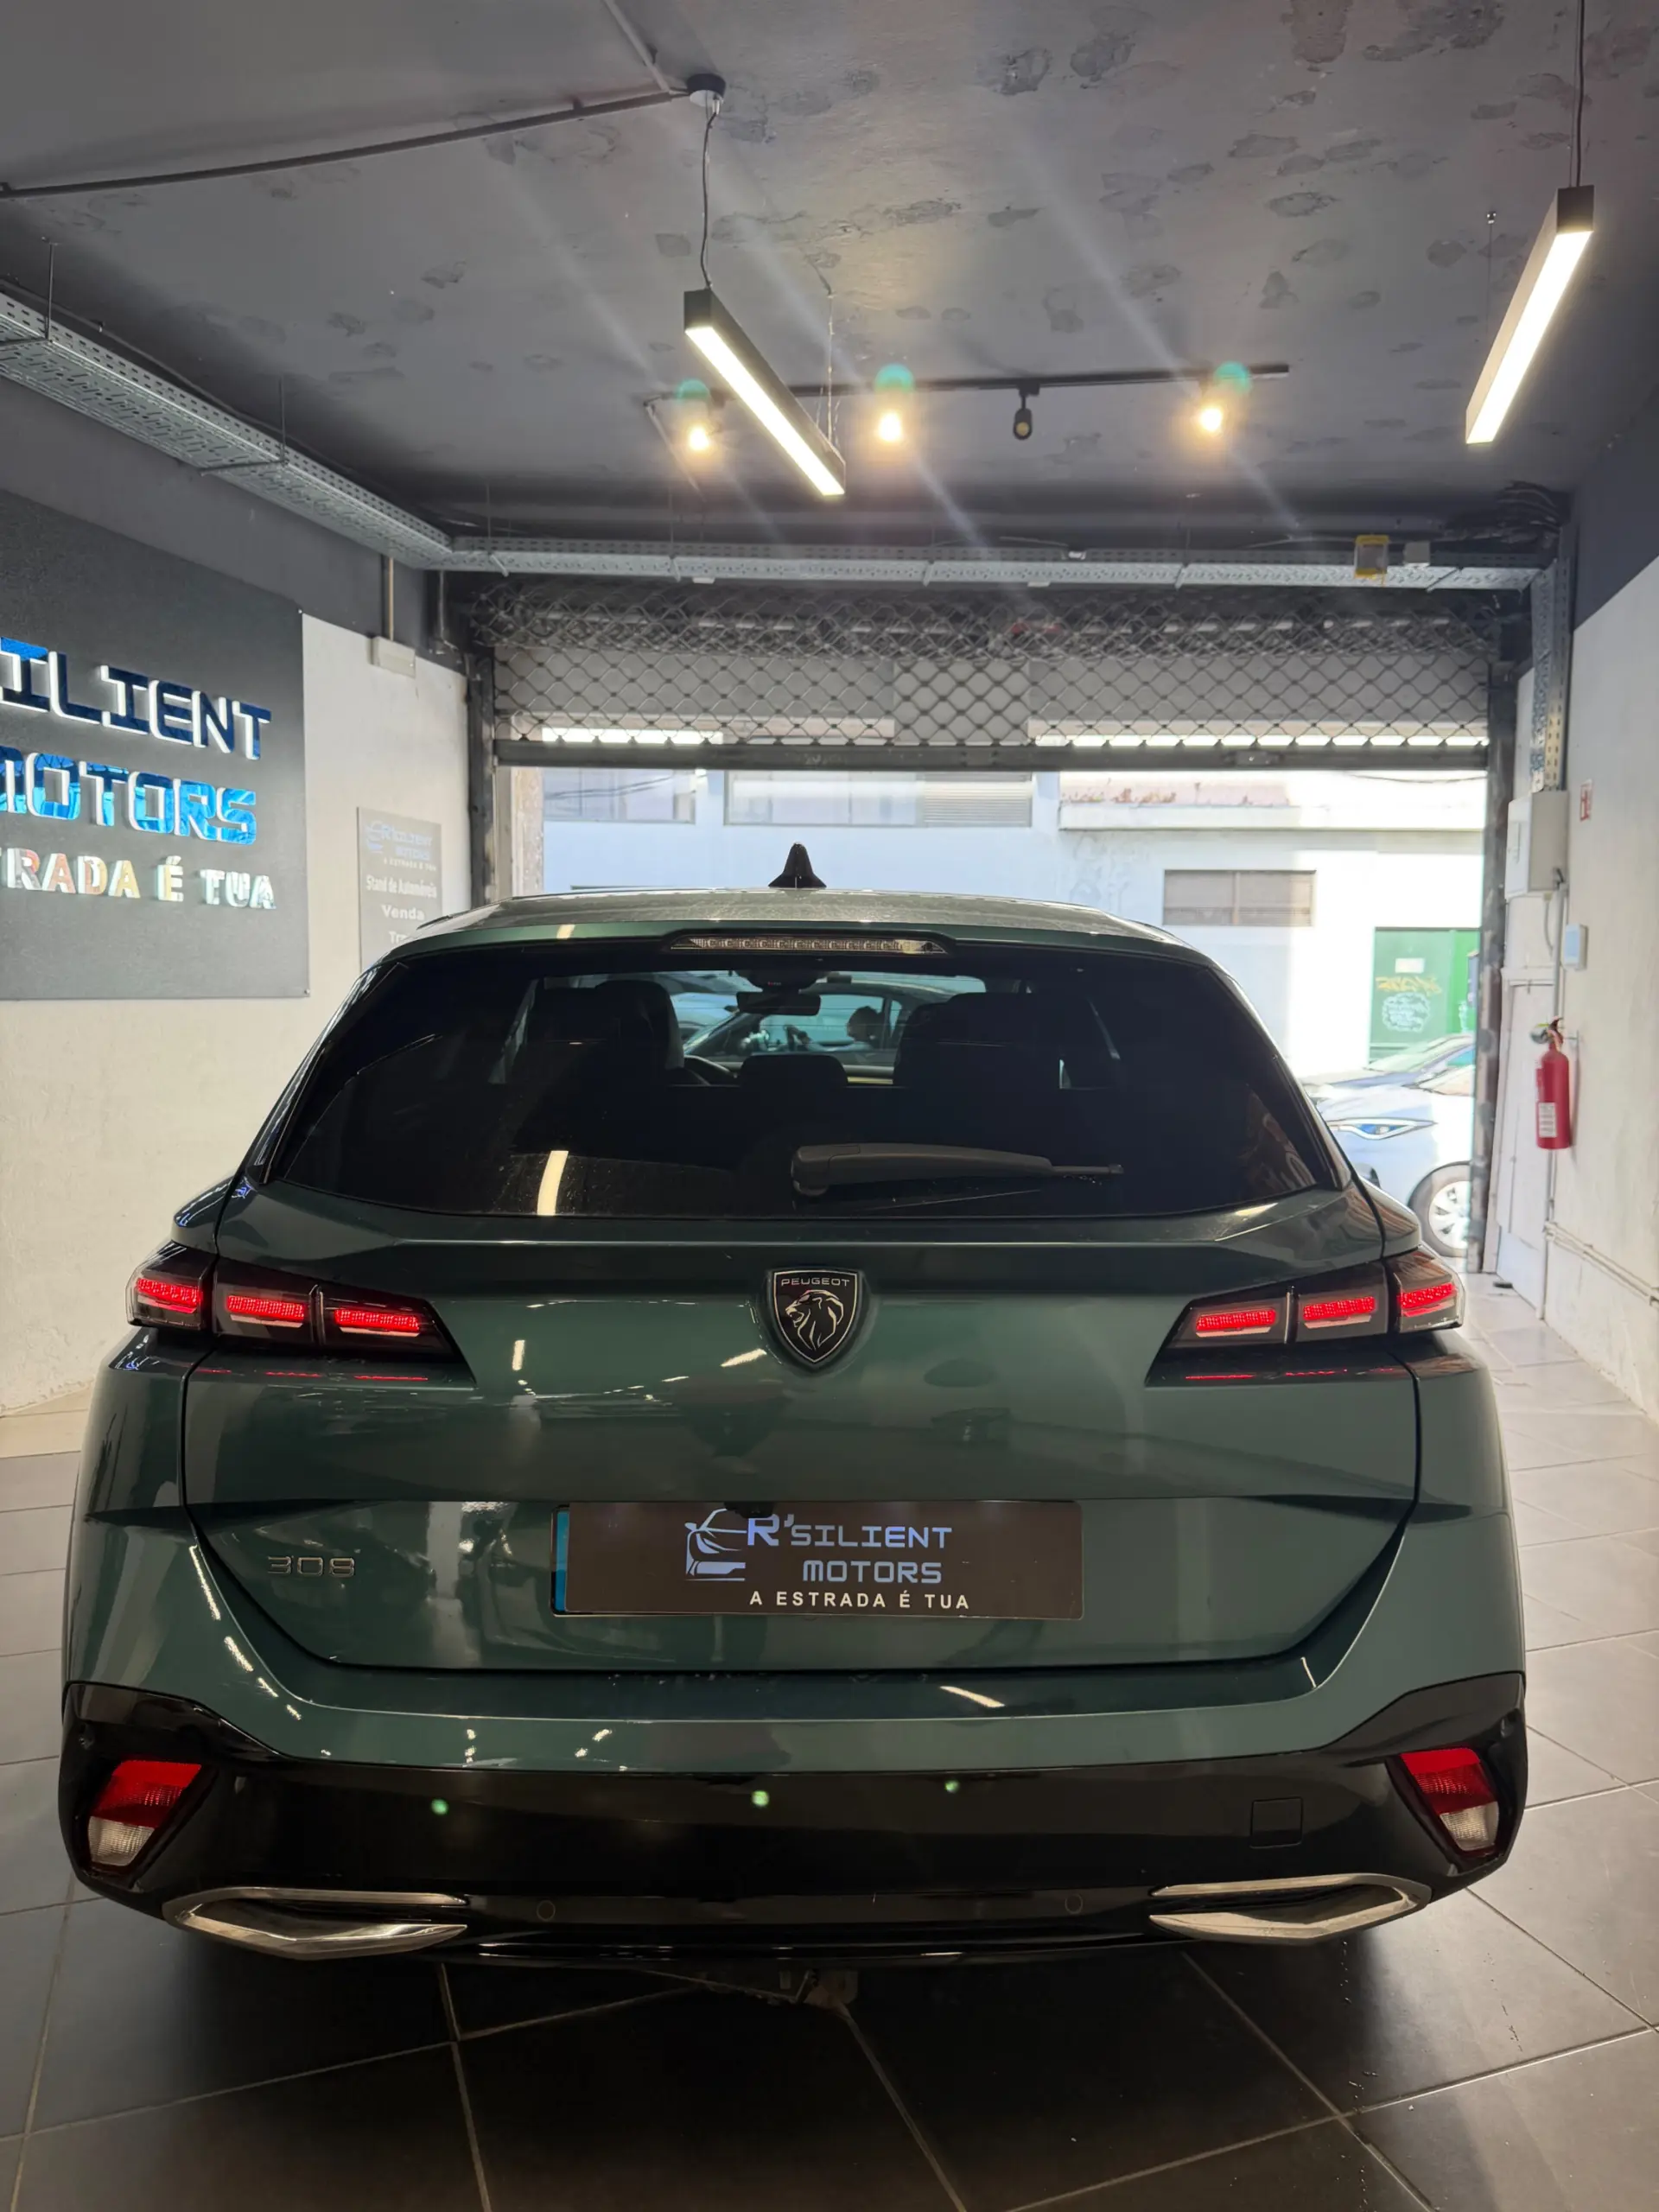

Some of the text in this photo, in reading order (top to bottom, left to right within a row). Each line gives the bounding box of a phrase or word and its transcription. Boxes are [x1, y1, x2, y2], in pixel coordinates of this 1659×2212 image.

[0, 847, 276, 910] RADA É TUA
[381, 905, 425, 921] Venda
[781, 1278, 850, 1287] PEUGEOT
[747, 1514, 952, 1548] R'SILIENT
[267, 1556, 355, 1577] 308
[803, 1560, 942, 1584] MOTORS
[749, 1590, 969, 1610] A ESTRADA É TUA
